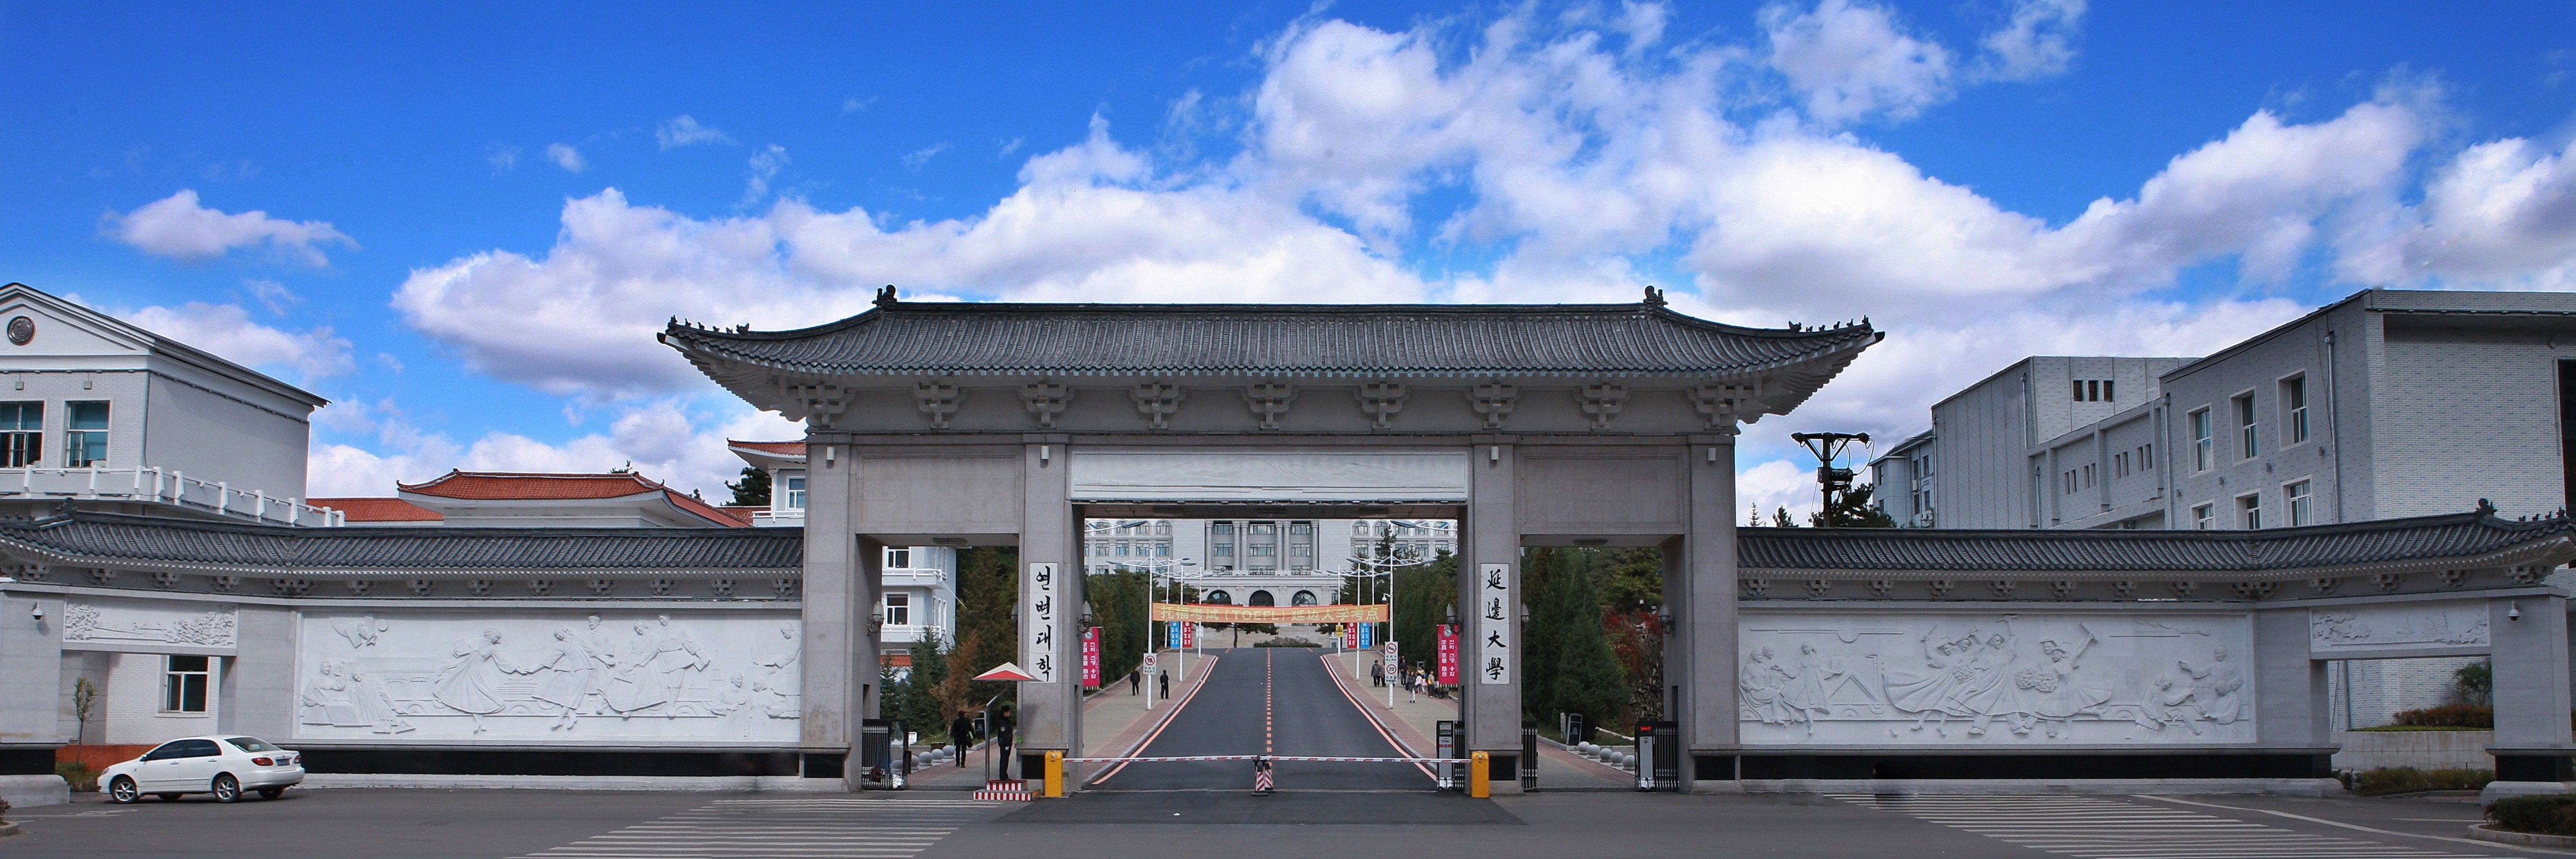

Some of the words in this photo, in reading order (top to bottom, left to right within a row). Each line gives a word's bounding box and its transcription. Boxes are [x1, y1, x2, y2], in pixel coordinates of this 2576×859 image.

[1035, 566, 1052, 682] 연변대학
[1485, 568, 1507, 680] 延邊大學
